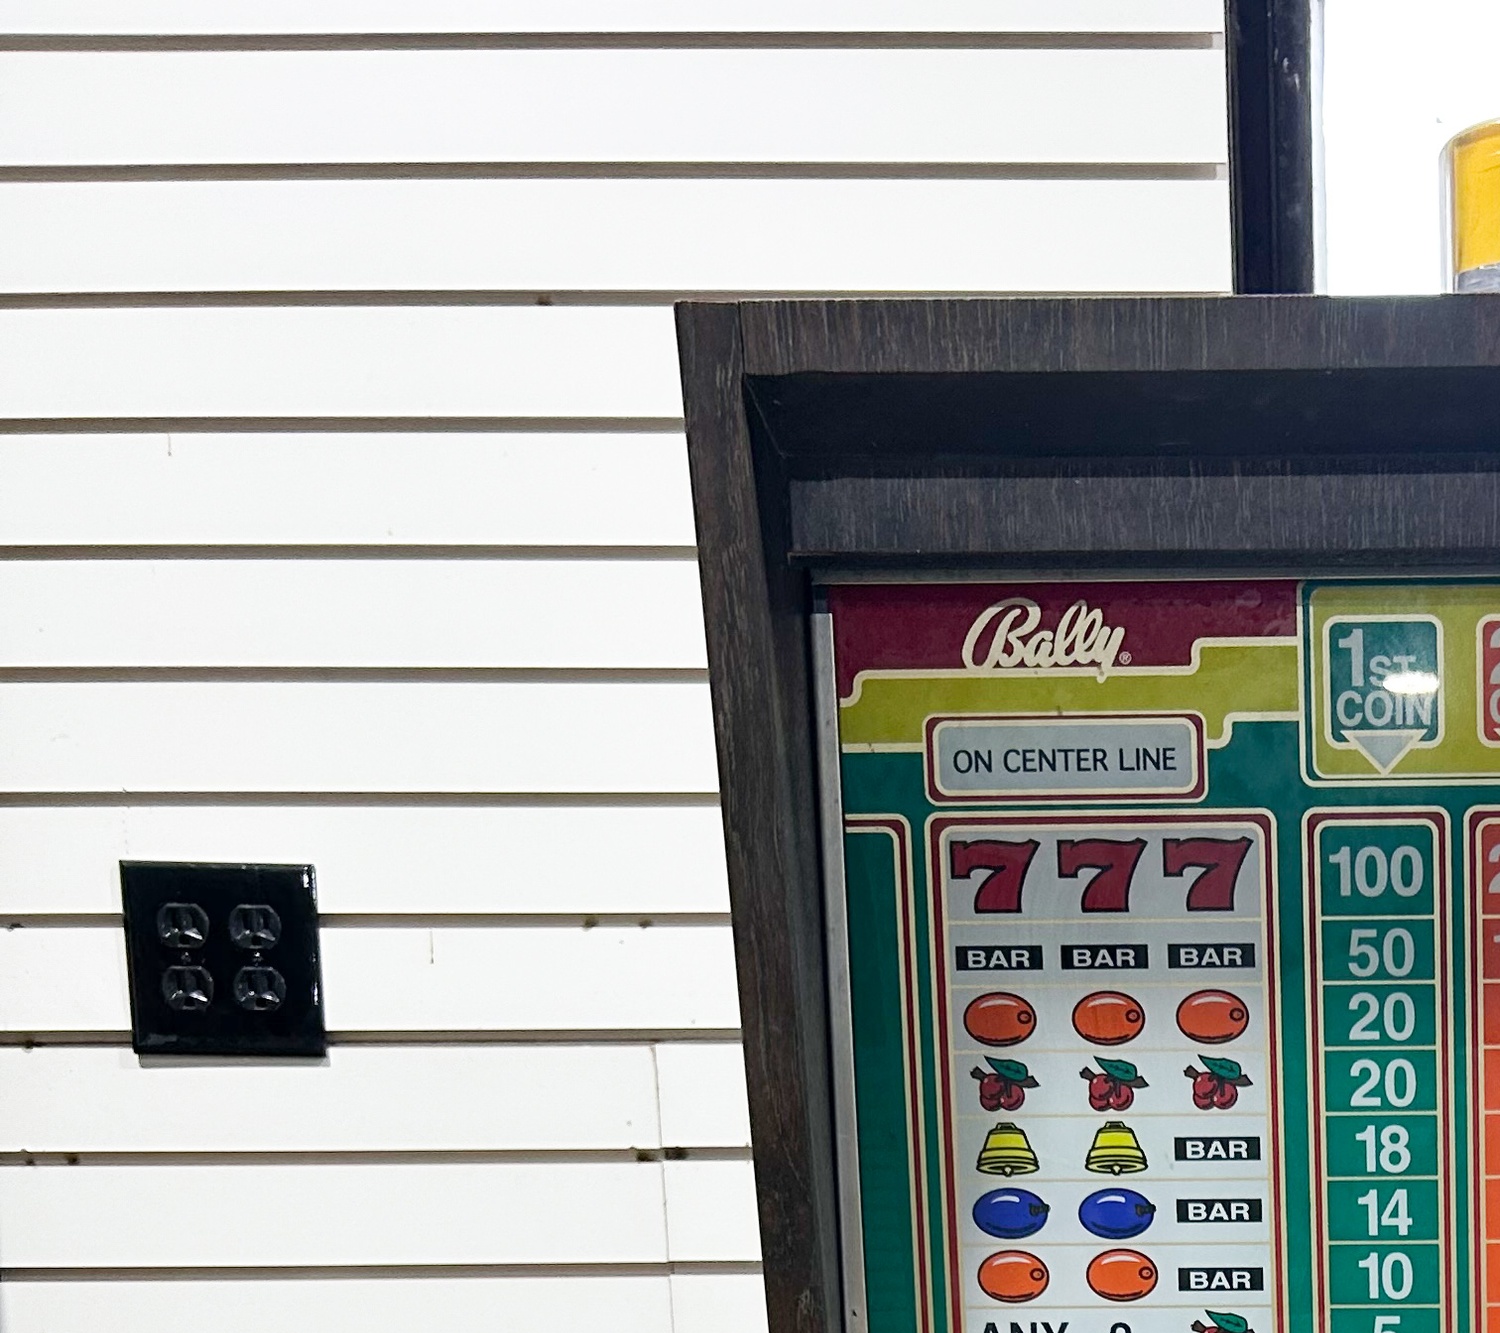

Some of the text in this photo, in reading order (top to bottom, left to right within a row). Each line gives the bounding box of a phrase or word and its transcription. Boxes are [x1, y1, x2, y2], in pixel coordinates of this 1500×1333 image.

[1339, 628, 1417, 687] 1ST
[1336, 690, 1433, 727] COIN
[953, 747, 1177, 774] ON CENTER LINE
[1329, 845, 1424, 897] 100
[968, 946, 1242, 968] BAR BAR BAR
[1347, 928, 1415, 977] 50
[1348, 992, 1416, 1041] 20
[1349, 1058, 1416, 1107] 20
[1186, 1140, 1249, 1159] BAR
[1355, 1124, 1411, 1173] 18
[1188, 1202, 1250, 1221] BAR
[1358, 1188, 1412, 1236] 14
[1190, 1271, 1252, 1289] BAR
[1359, 1251, 1413, 1300] 10
